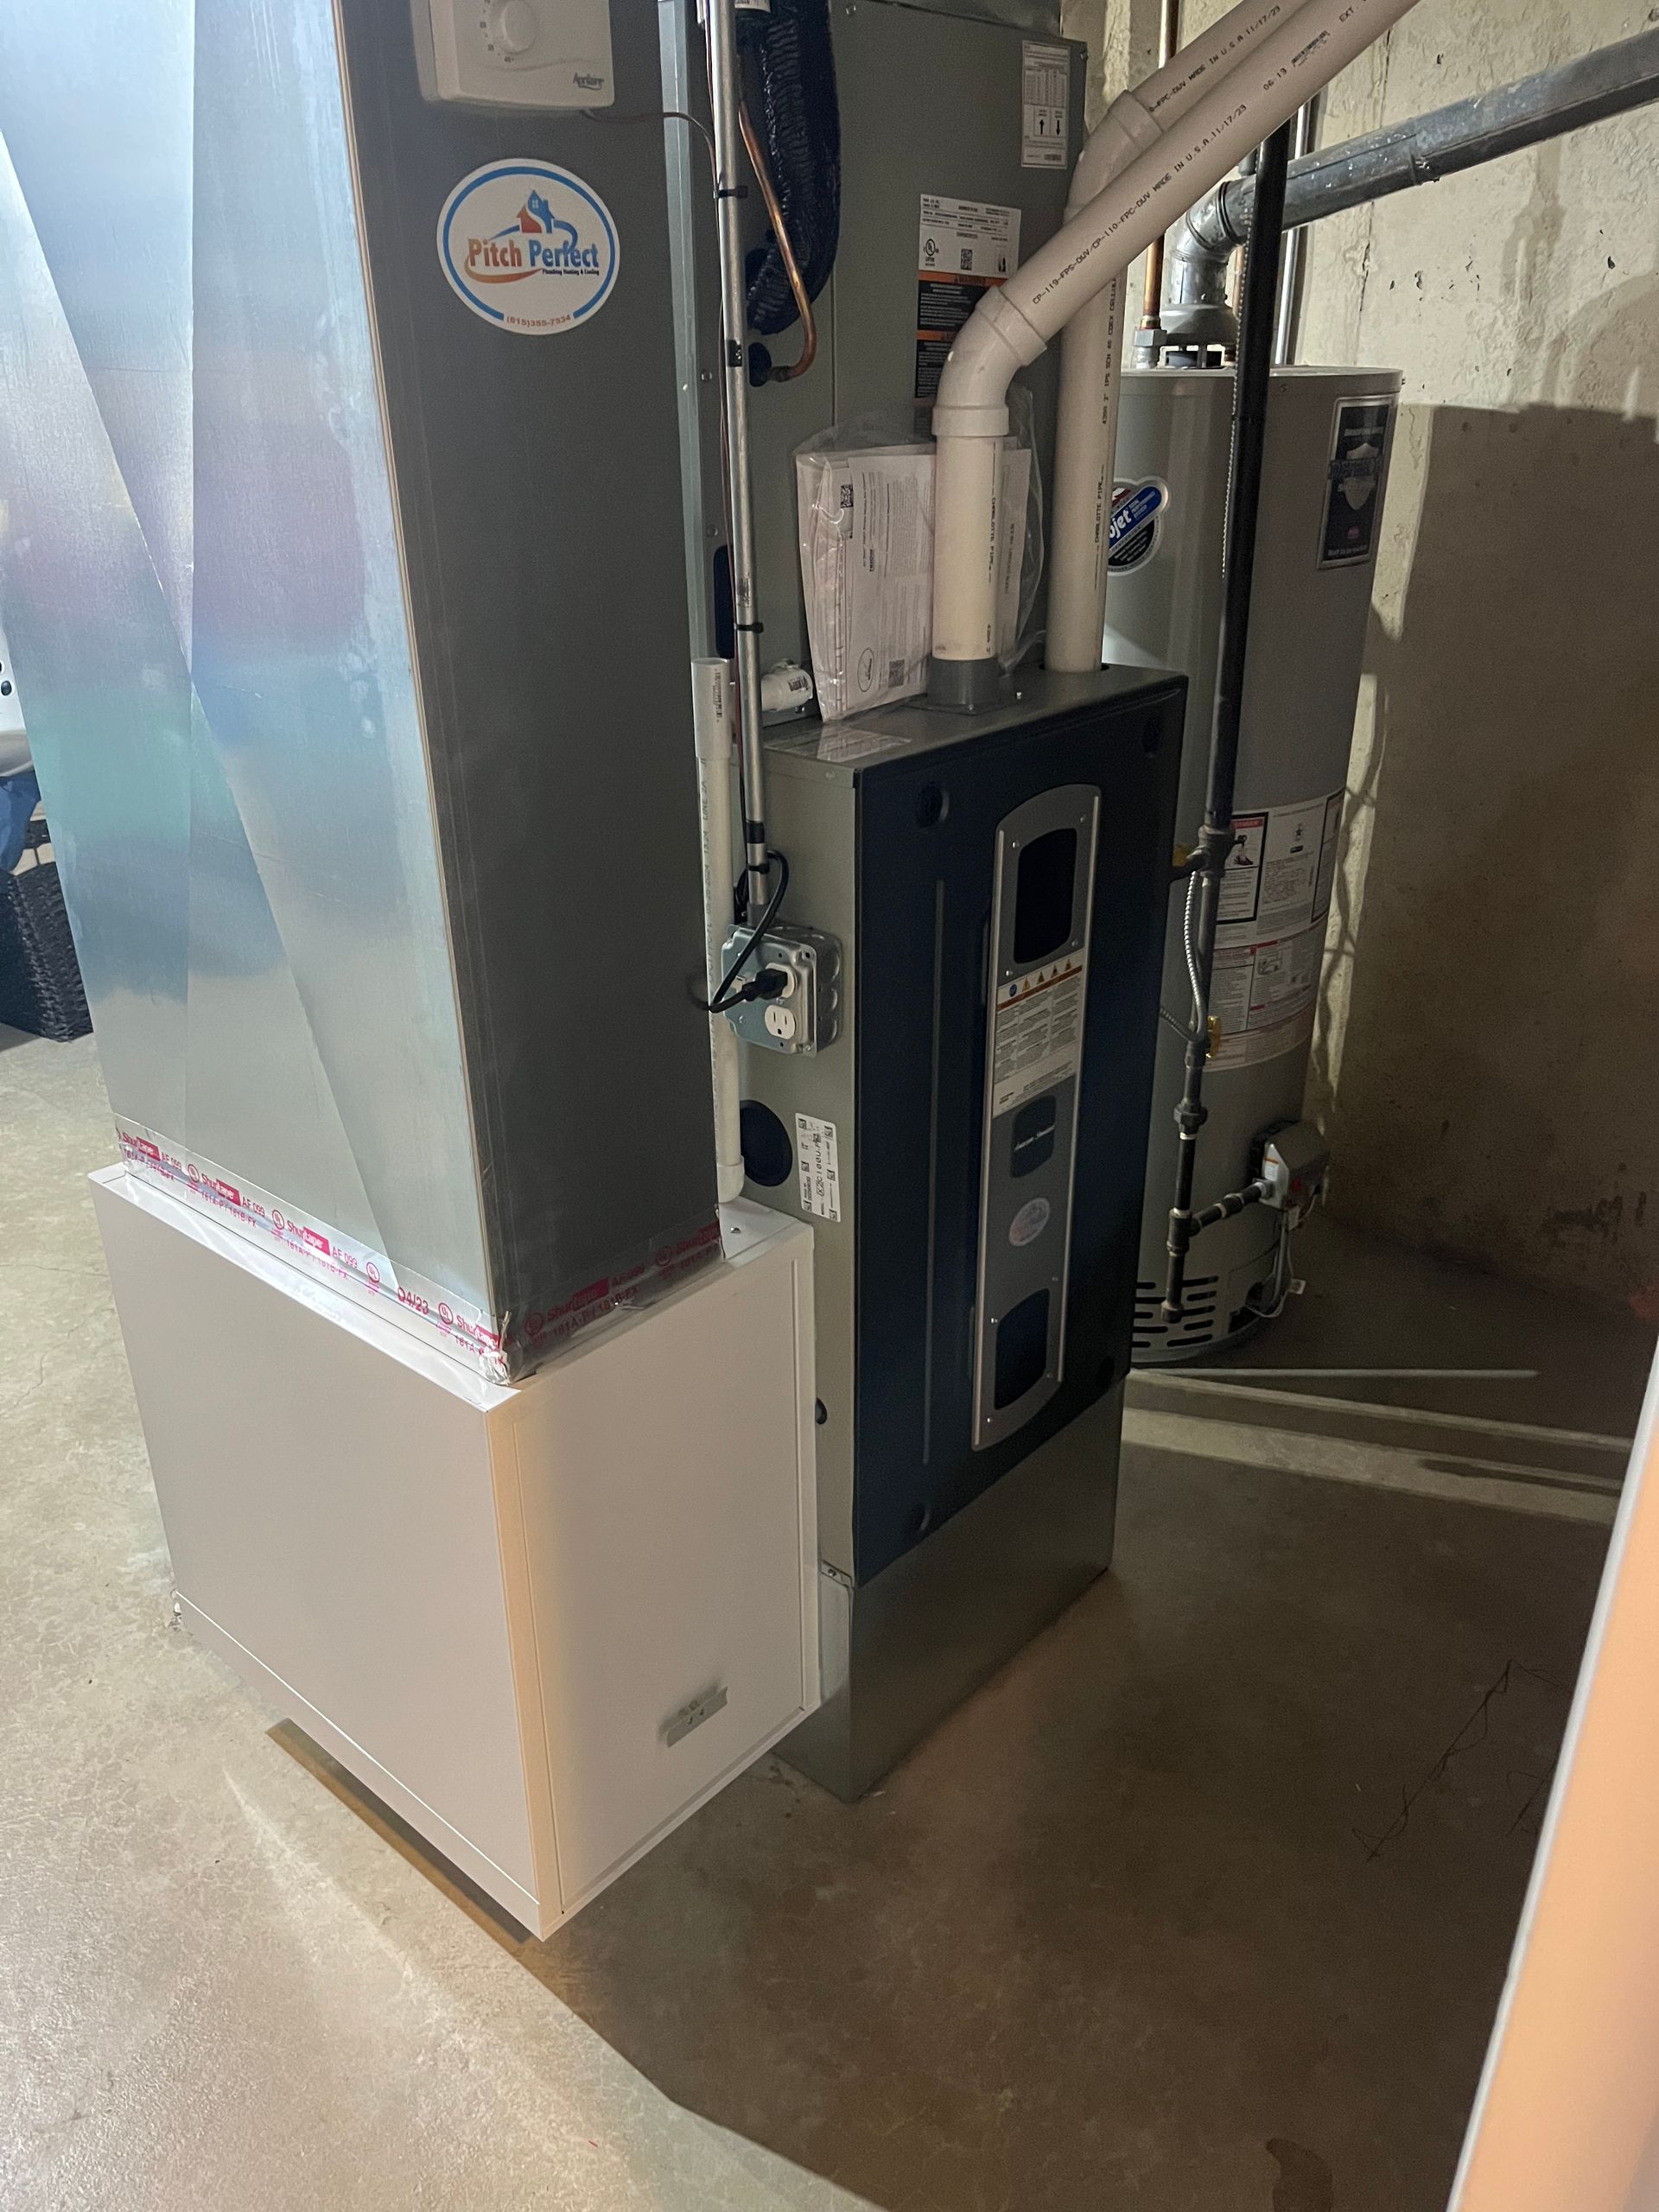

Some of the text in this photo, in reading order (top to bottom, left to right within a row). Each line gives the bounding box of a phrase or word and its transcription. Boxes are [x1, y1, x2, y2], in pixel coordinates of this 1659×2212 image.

[1188, 64, 1206, 81] MADE
[1209, 54, 1219, 66] IN
[1153, 175, 1173, 192] MADE
[1173, 159, 1185, 173] IN
[467, 238, 600, 269] Pitch Perfect
[201, 1173, 237, 1199] Shurtape
[287, 1220, 325, 1249] Shurtape
[332, 1246, 343, 1259] AF
[397, 1287, 429, 1315] Q4/23
